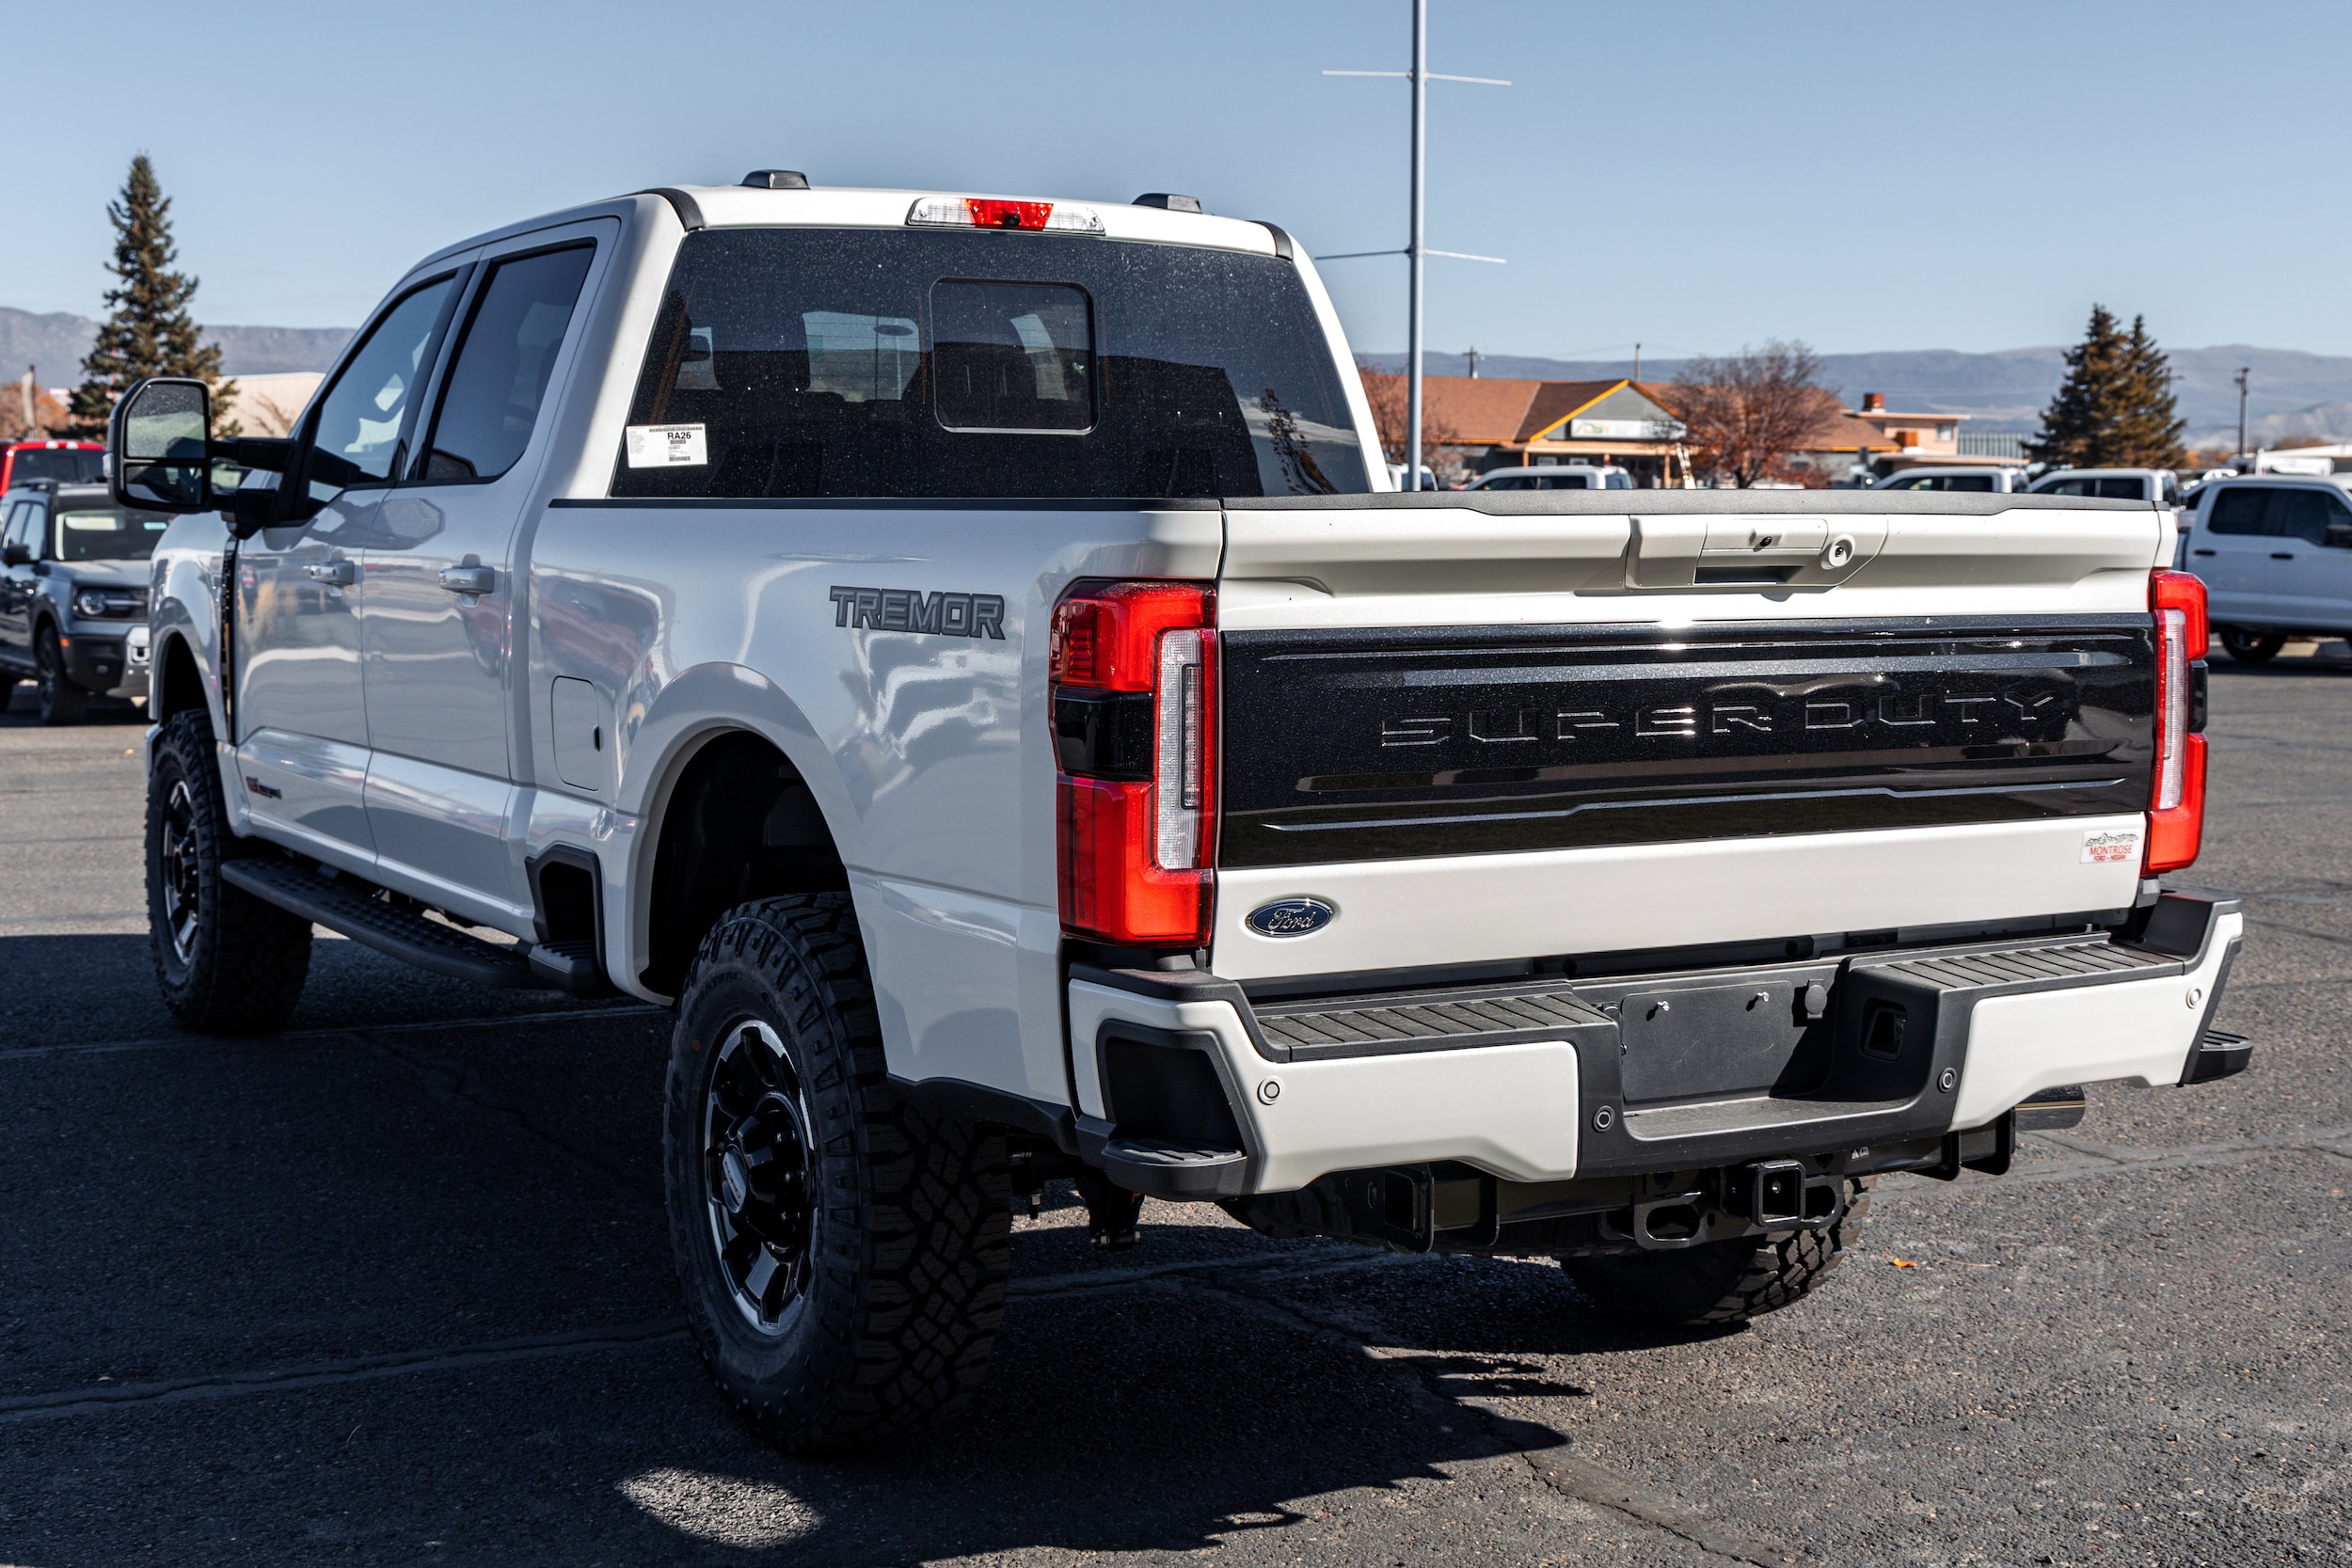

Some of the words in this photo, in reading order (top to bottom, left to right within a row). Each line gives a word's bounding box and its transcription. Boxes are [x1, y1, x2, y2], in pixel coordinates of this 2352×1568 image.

[667, 431, 691, 440] RA26
[830, 586, 1006, 641] TREMOR
[1381, 702, 1773, 747] SUPER
[1805, 690, 2058, 730] DUTY
[2089, 845, 2134, 856] MONTROSE
[1268, 908, 1316, 930] Ford
